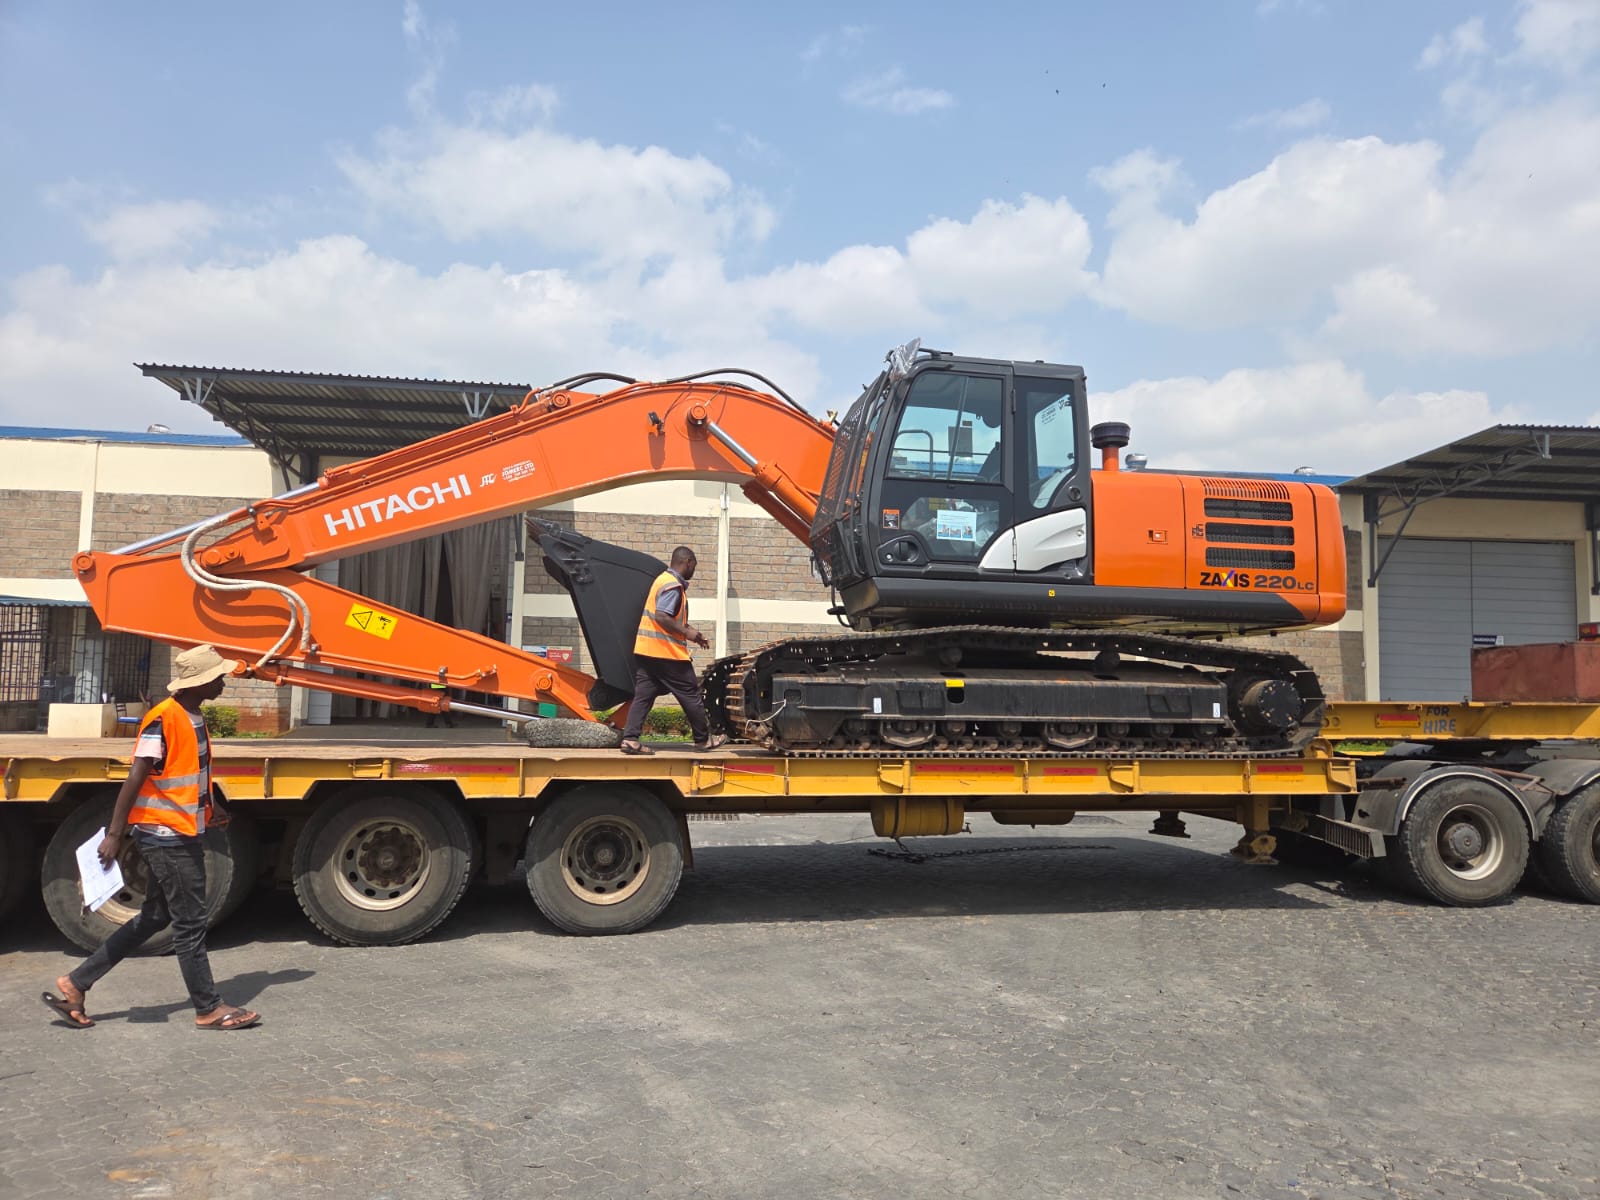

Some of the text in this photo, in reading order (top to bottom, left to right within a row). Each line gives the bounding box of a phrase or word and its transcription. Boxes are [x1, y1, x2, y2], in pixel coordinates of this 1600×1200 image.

[323, 473, 472, 536] HITACHI
[1200, 570, 1250, 588] ZAXIS
[1426, 706, 1449, 716] FOR
[1423, 719, 1456, 734] HIRE
